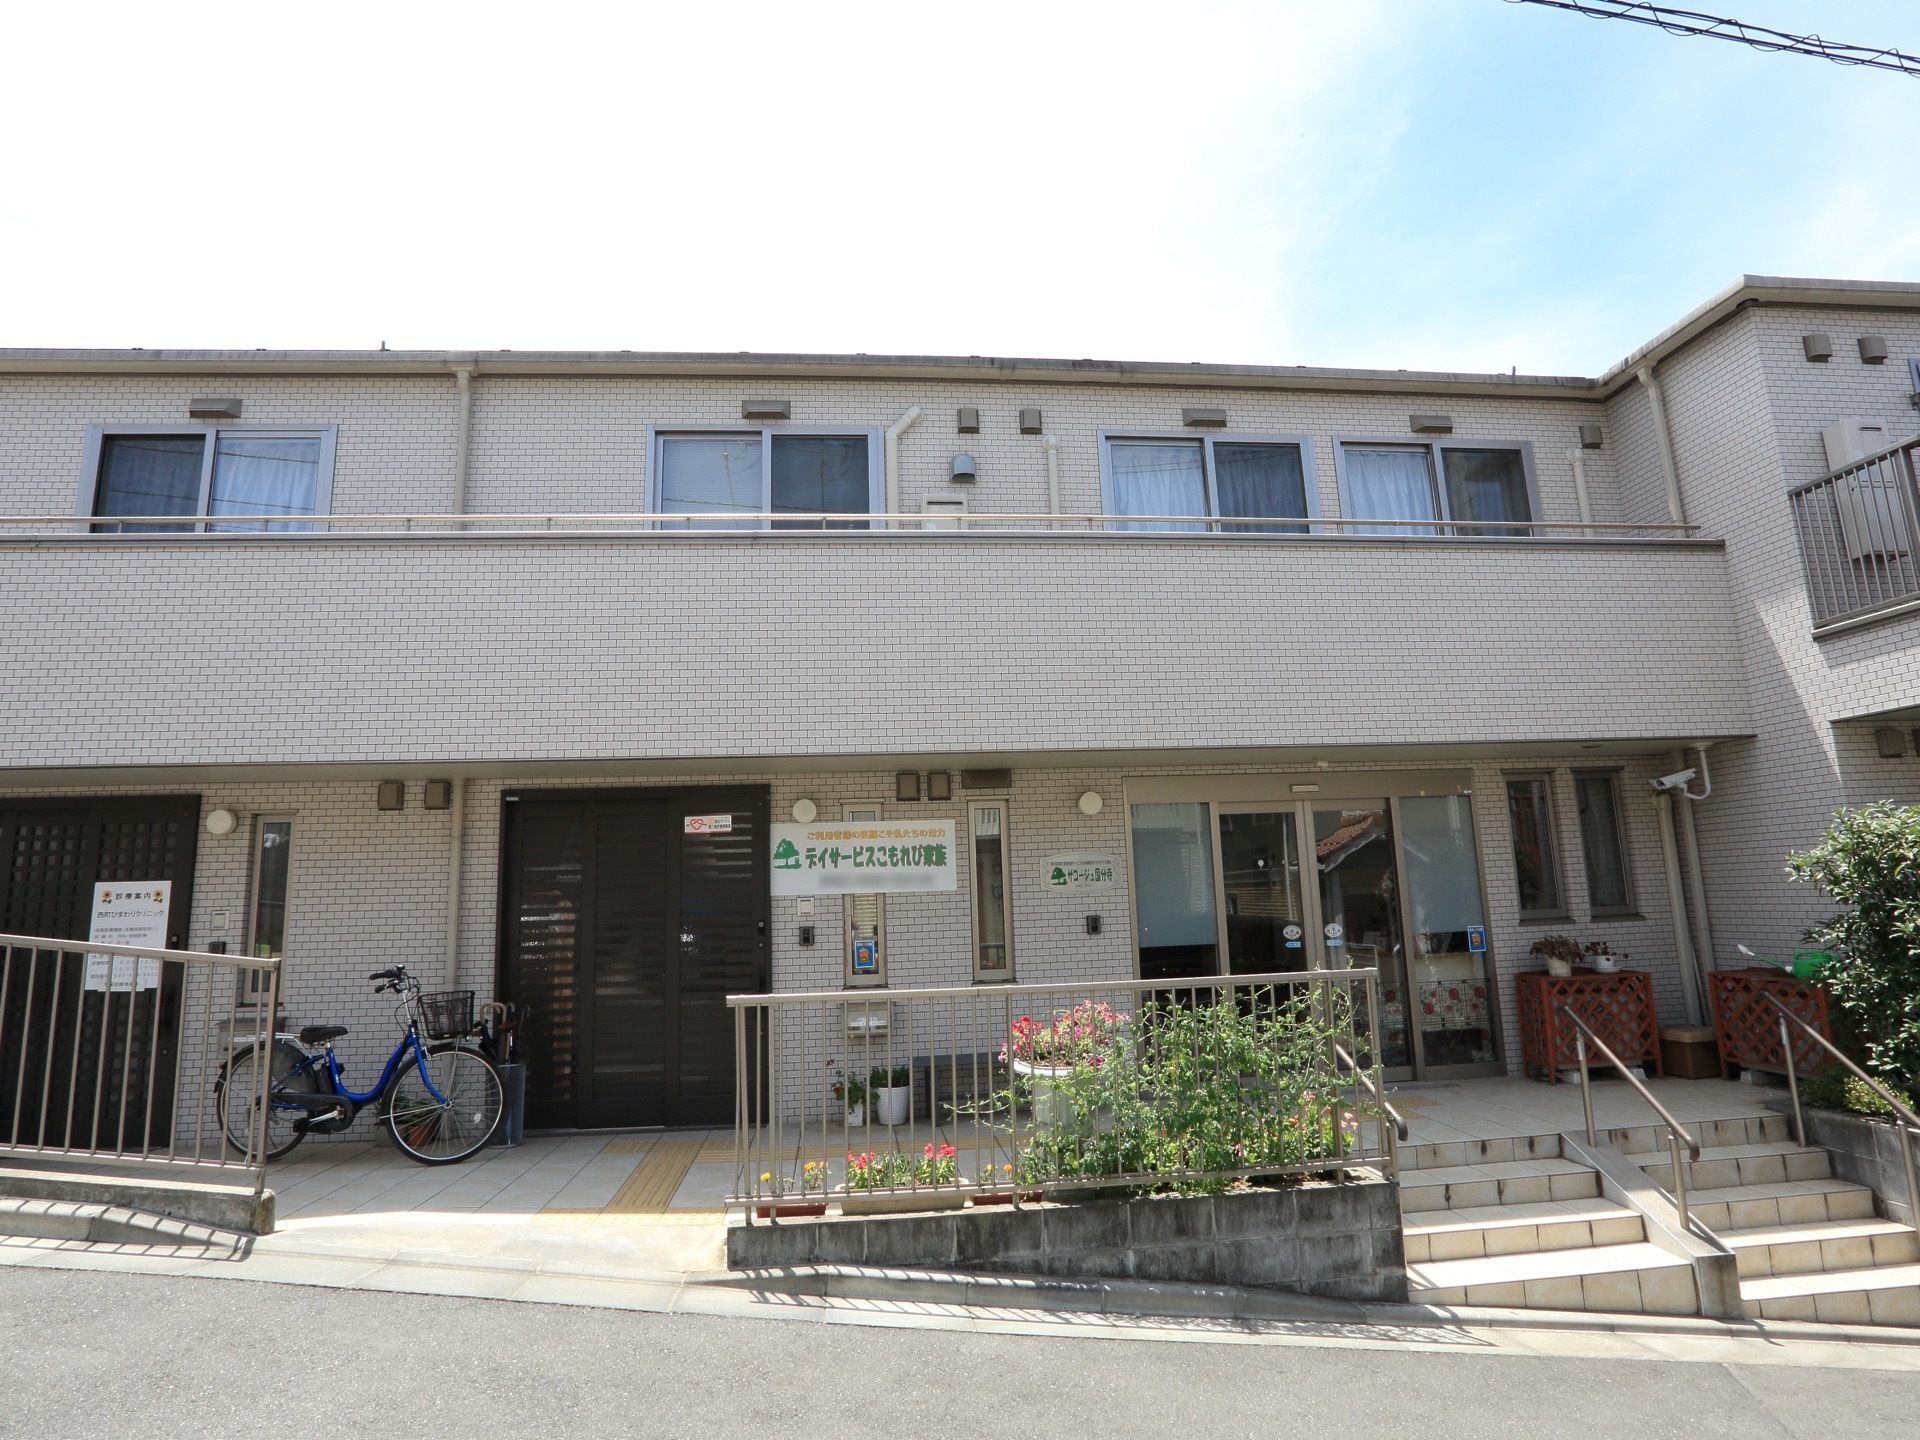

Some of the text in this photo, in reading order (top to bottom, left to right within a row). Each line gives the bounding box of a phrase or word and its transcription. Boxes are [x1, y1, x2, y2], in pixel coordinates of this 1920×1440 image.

[805, 843, 947, 868] デイサービスこもれび家族
[1067, 867, 1113, 882] サコージュ国分寺
[115, 892, 151, 900] 診療案内
[97, 910, 164, 918] 西町ひまわりクリニック
